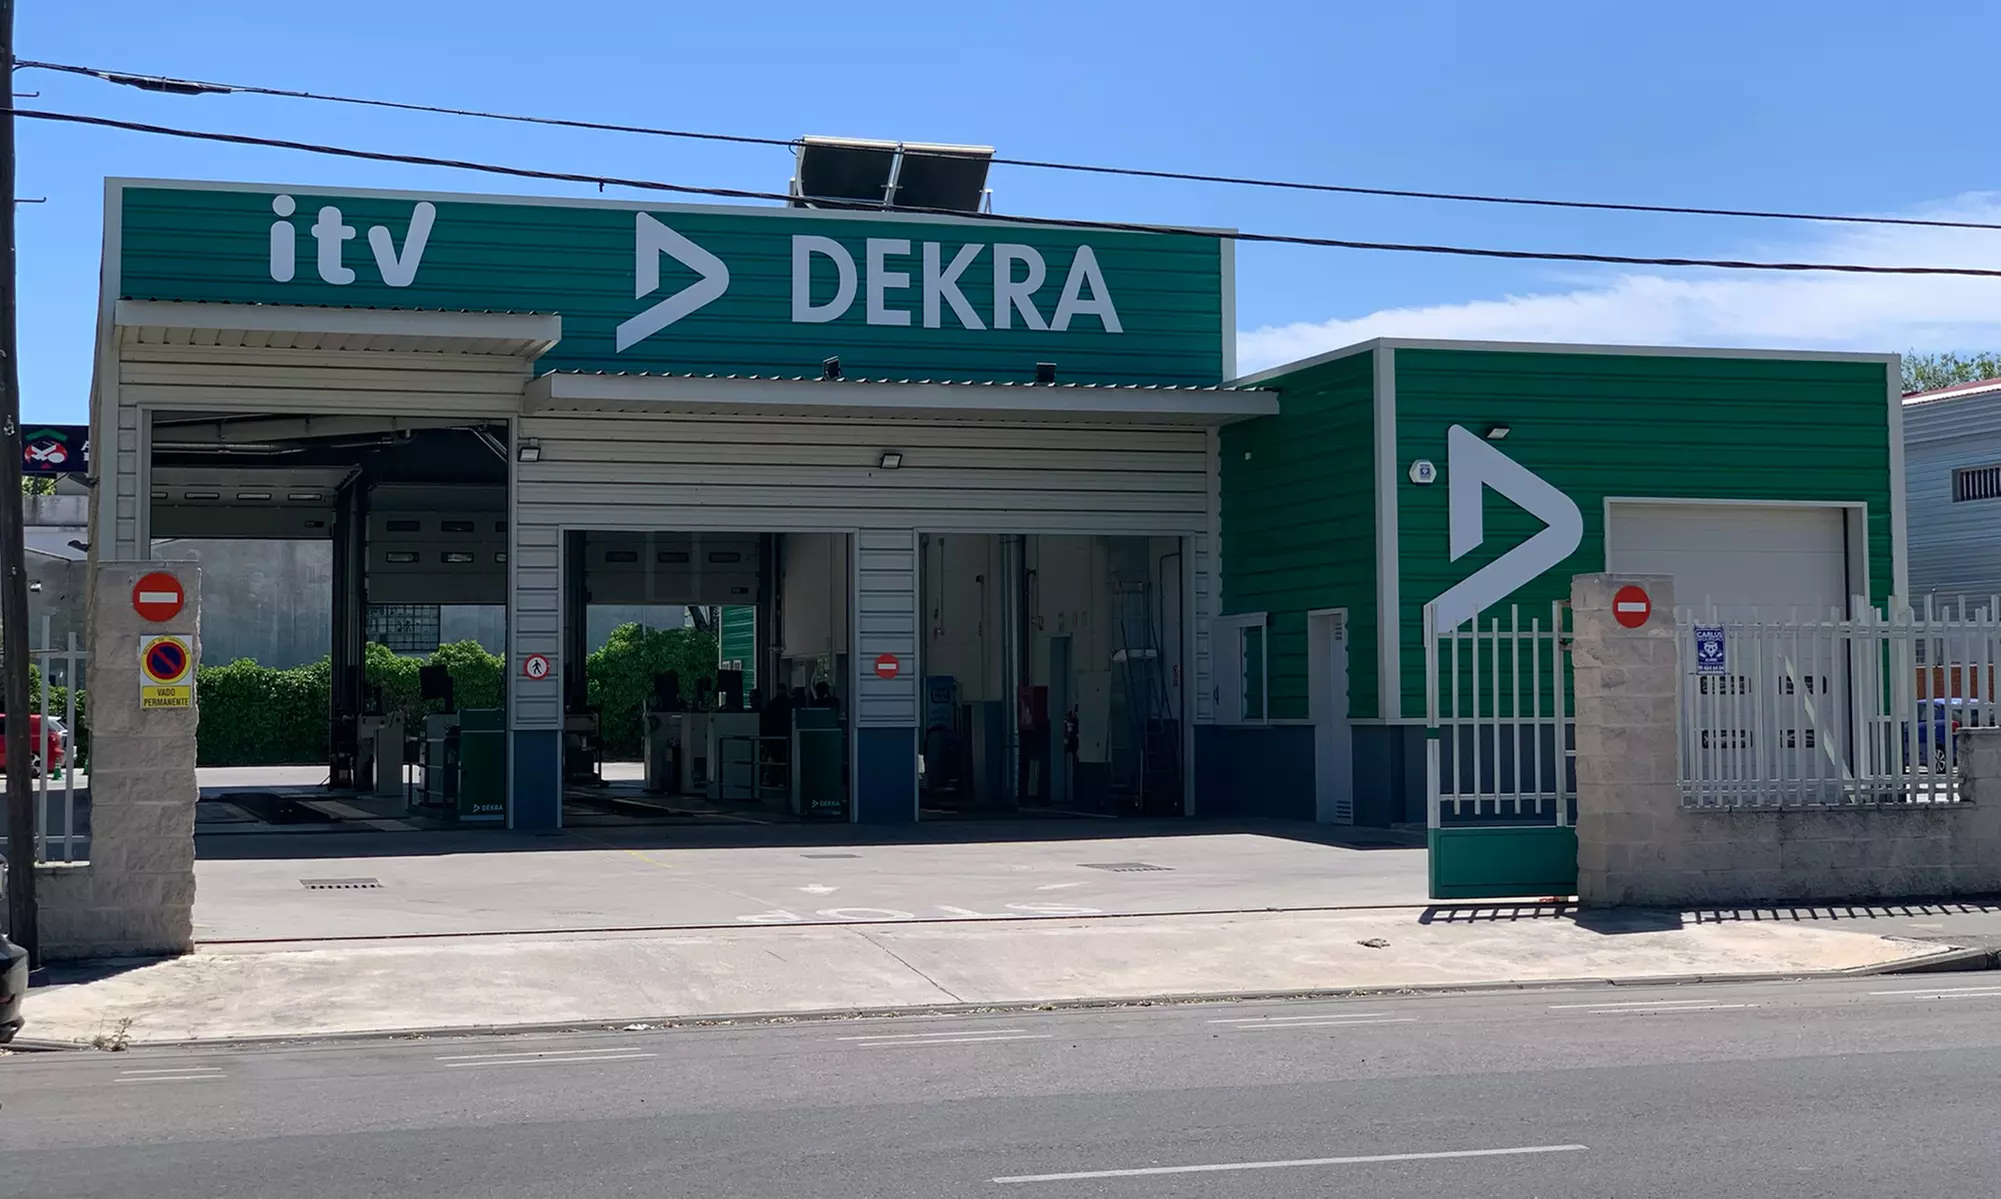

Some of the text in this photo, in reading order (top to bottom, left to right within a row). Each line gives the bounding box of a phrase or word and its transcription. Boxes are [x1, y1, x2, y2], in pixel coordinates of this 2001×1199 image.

[269, 193, 437, 288] itv
[792, 235, 1123, 333] DEKRA
[143, 697, 189, 706] PERMANENTE
[157, 688, 176, 696] VADO
